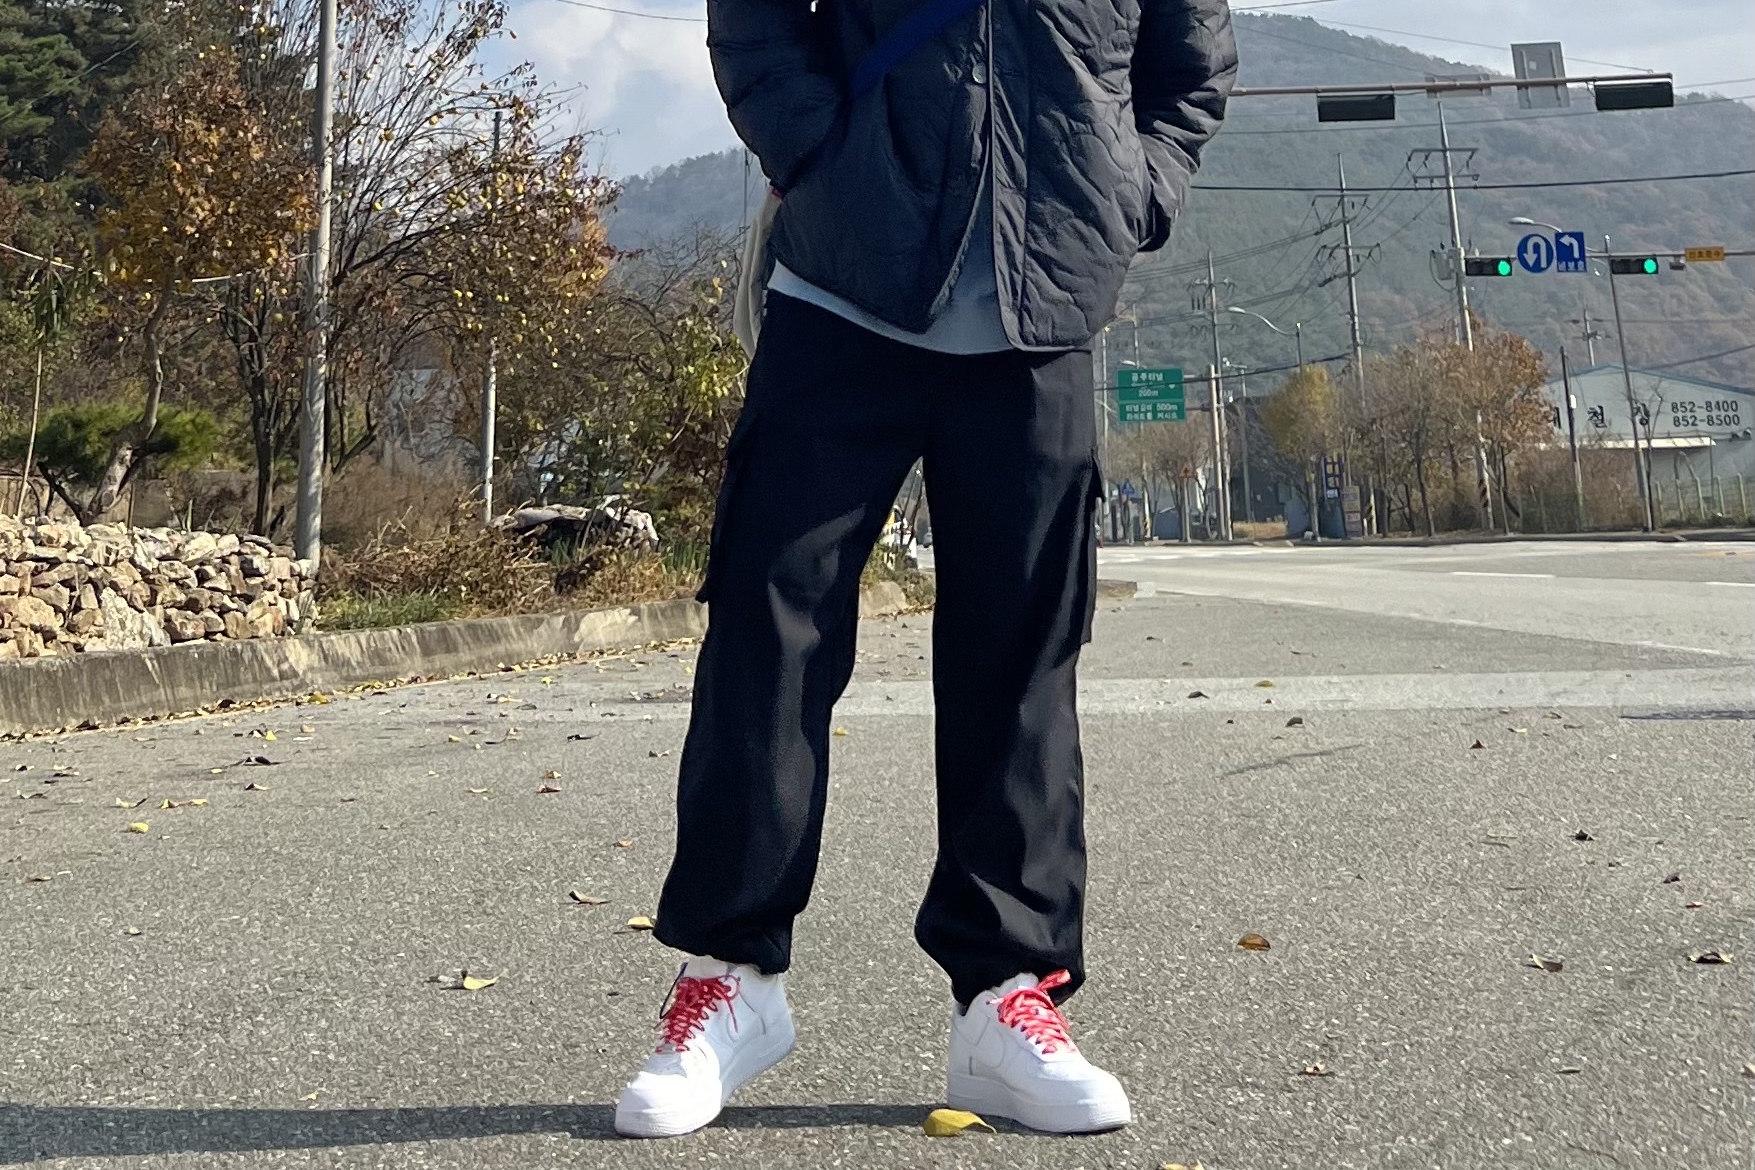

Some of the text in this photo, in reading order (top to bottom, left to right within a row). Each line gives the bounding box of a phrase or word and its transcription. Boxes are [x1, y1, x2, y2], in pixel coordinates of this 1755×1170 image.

[1558, 260, 1585, 272] 비보호
[1671, 400, 1739, 413] 852-8400
[1673, 414, 1741, 427] 852-8500
